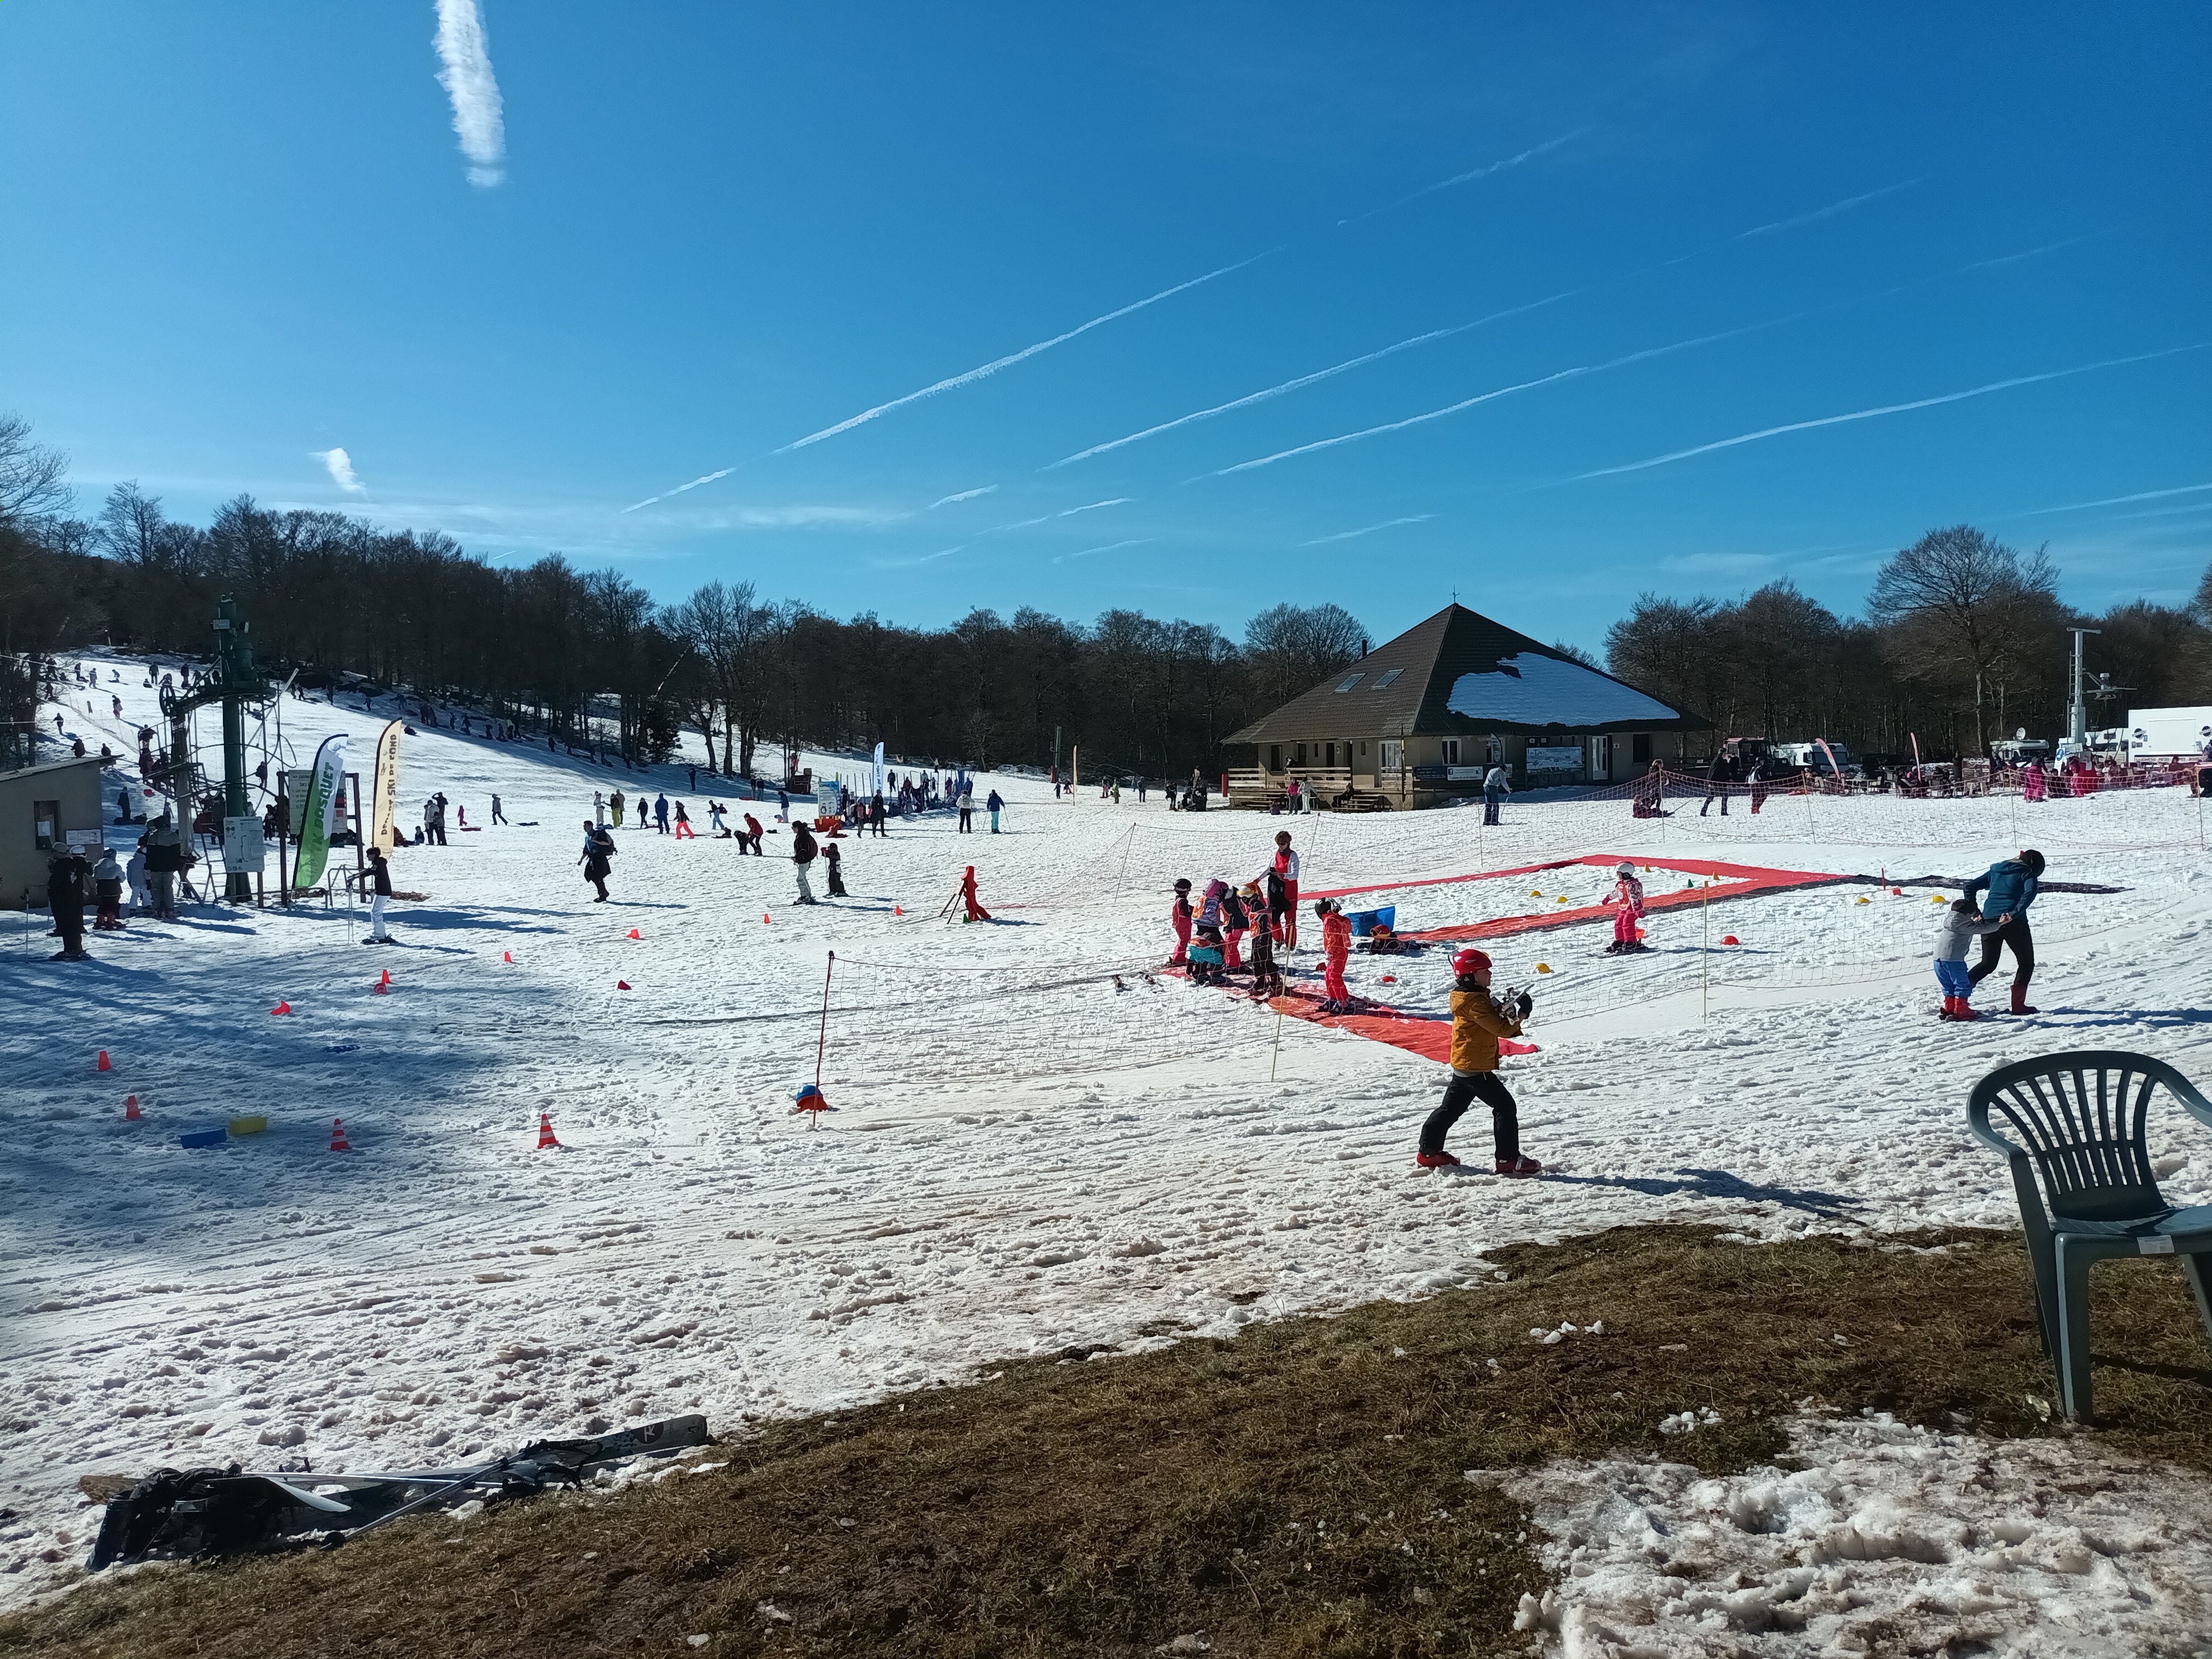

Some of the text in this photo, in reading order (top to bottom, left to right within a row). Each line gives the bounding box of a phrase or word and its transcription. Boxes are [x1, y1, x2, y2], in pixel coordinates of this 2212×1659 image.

[389, 734, 397, 760] FOND
[314, 761, 334, 828] BOSQUET
[387, 779, 396, 796] SKI
